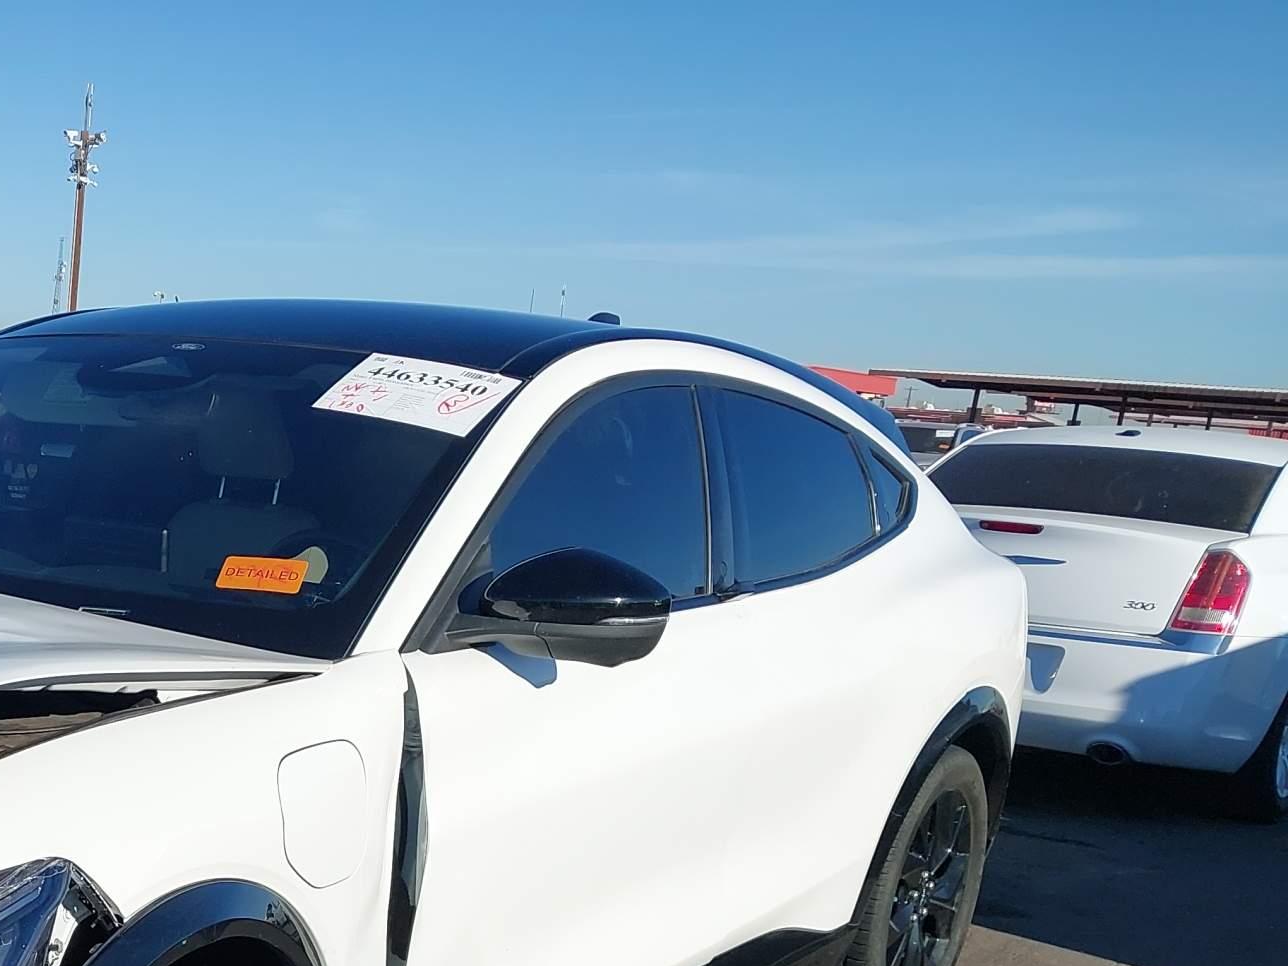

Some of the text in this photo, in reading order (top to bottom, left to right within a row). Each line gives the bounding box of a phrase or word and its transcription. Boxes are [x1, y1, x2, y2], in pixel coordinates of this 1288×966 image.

[368, 366, 488, 396] 44633540
[224, 567, 299, 581] DETAILED
[1123, 600, 1157, 611] 300
